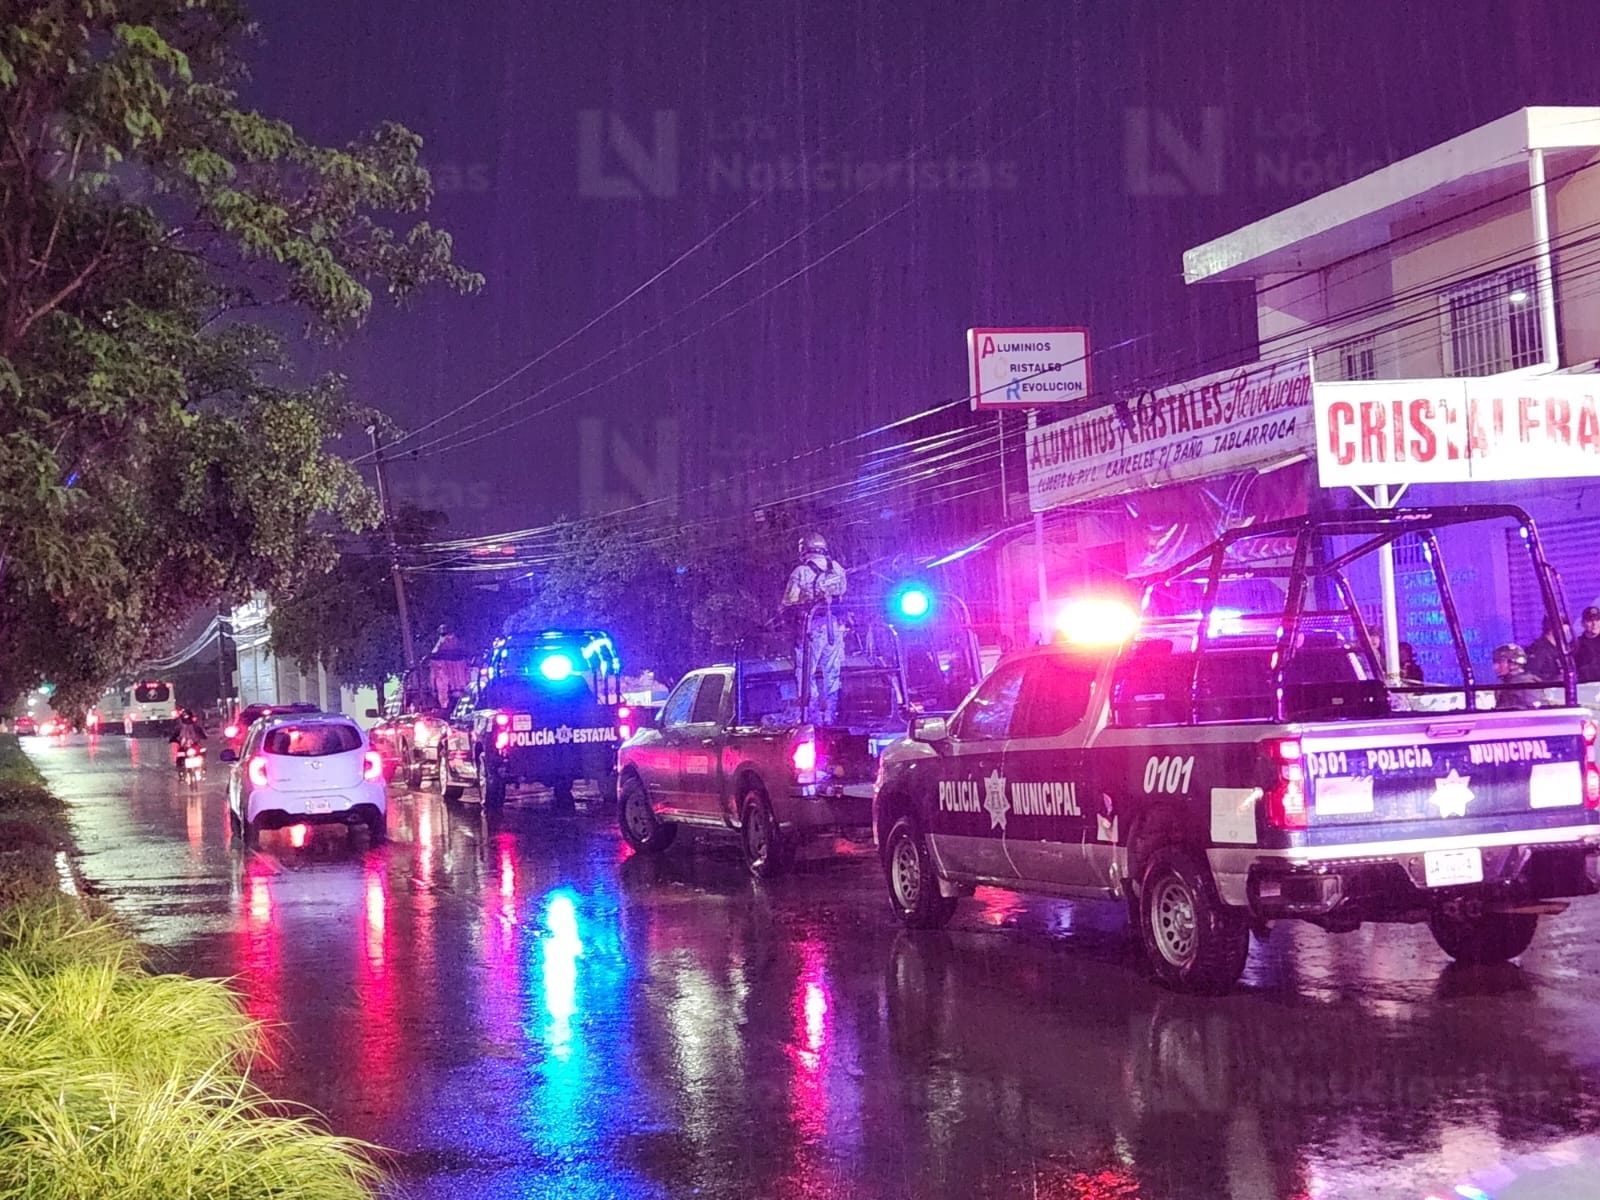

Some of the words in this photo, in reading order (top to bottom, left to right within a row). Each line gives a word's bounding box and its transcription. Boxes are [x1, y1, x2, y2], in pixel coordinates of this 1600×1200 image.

[982, 336, 1052, 359] ALUMINIOS
[1006, 377, 1082, 400] REVOLUCION
[1030, 414, 1116, 470] ALUMINIOS
[1213, 416, 1297, 455] TABLARROCA
[510, 728, 556, 747] POLICÍA
[573, 727, 617, 743] ESTATAL
[1143, 755, 1195, 794] 0101
[1307, 751, 1348, 777] 0101
[1365, 744, 1433, 771] POLICÍA
[1468, 740, 1552, 766] MUNICIPAL
[939, 773, 982, 813] POLICÍA
[1011, 782, 1081, 816] MUNICIPAL
